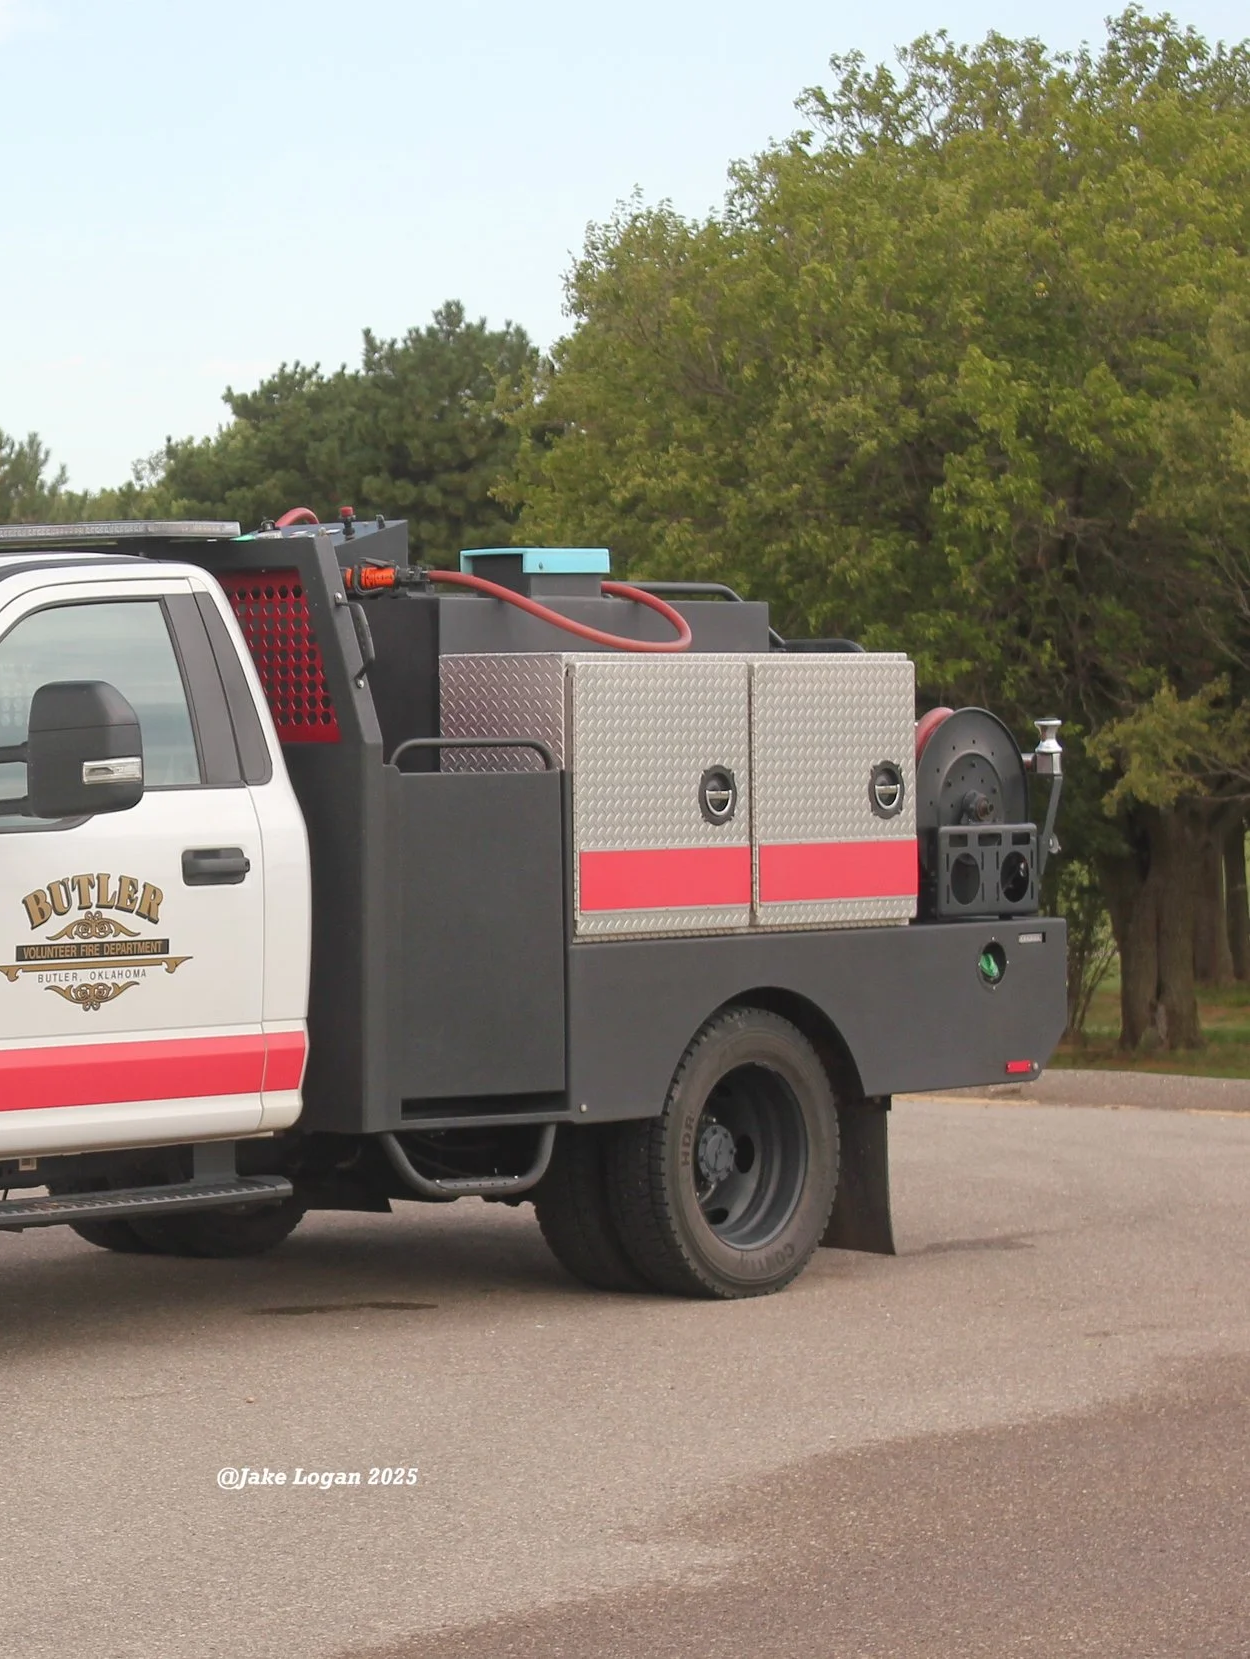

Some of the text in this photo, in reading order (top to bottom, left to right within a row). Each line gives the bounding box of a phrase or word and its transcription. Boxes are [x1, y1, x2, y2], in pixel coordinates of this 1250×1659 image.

[22, 873, 164, 930] BUTLER
[22, 940, 163, 960] VOLUNTEER FIRE DEPARTMENT
[37, 969, 147, 983] BUTLER, OKLAHOMA
